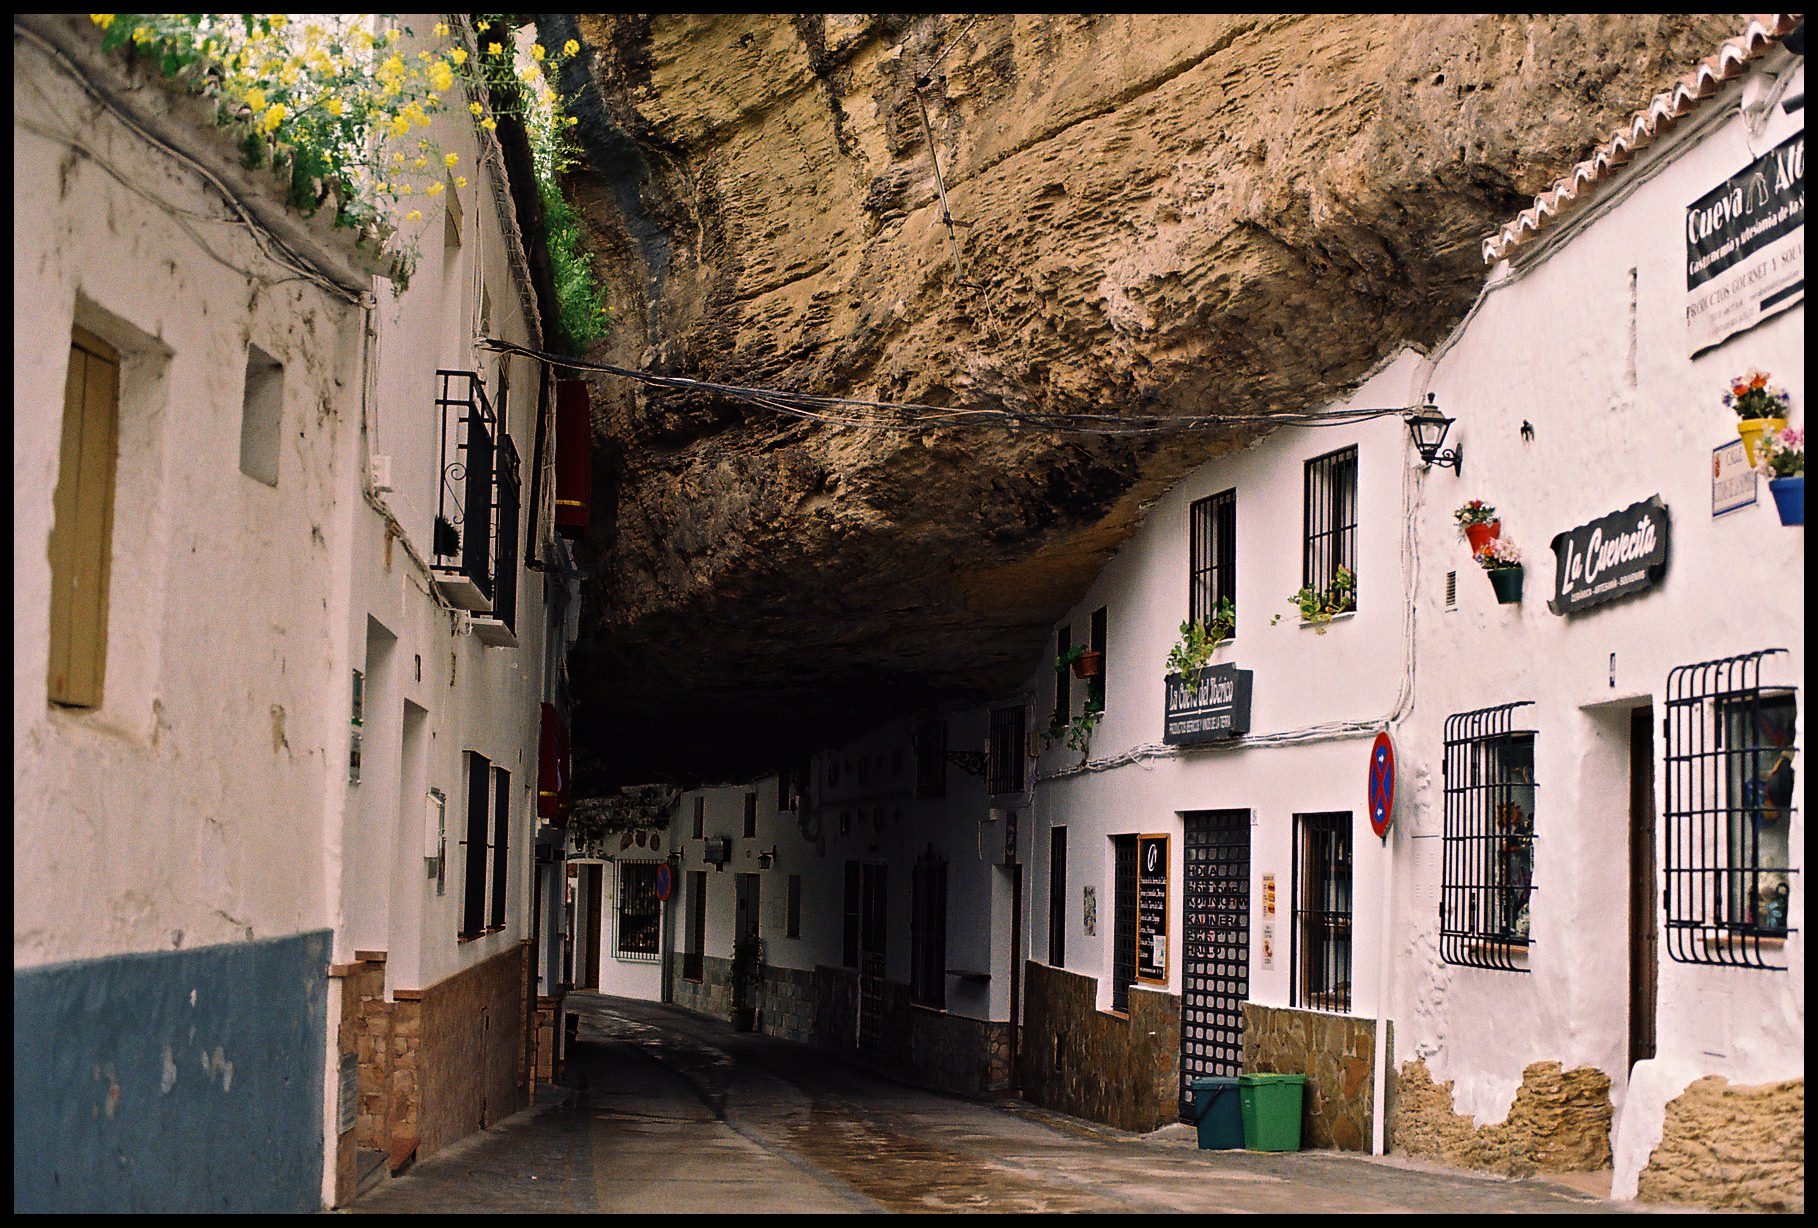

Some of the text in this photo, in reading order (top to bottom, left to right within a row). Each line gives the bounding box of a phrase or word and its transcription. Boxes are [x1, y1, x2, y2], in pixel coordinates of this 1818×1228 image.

[1688, 187, 1743, 244] Cueva
[1562, 514, 1657, 595] La Cuevecita
[1169, 684, 1178, 711] La
[1199, 679, 1209, 707] del
[1210, 676, 1234, 705] Ibérico
